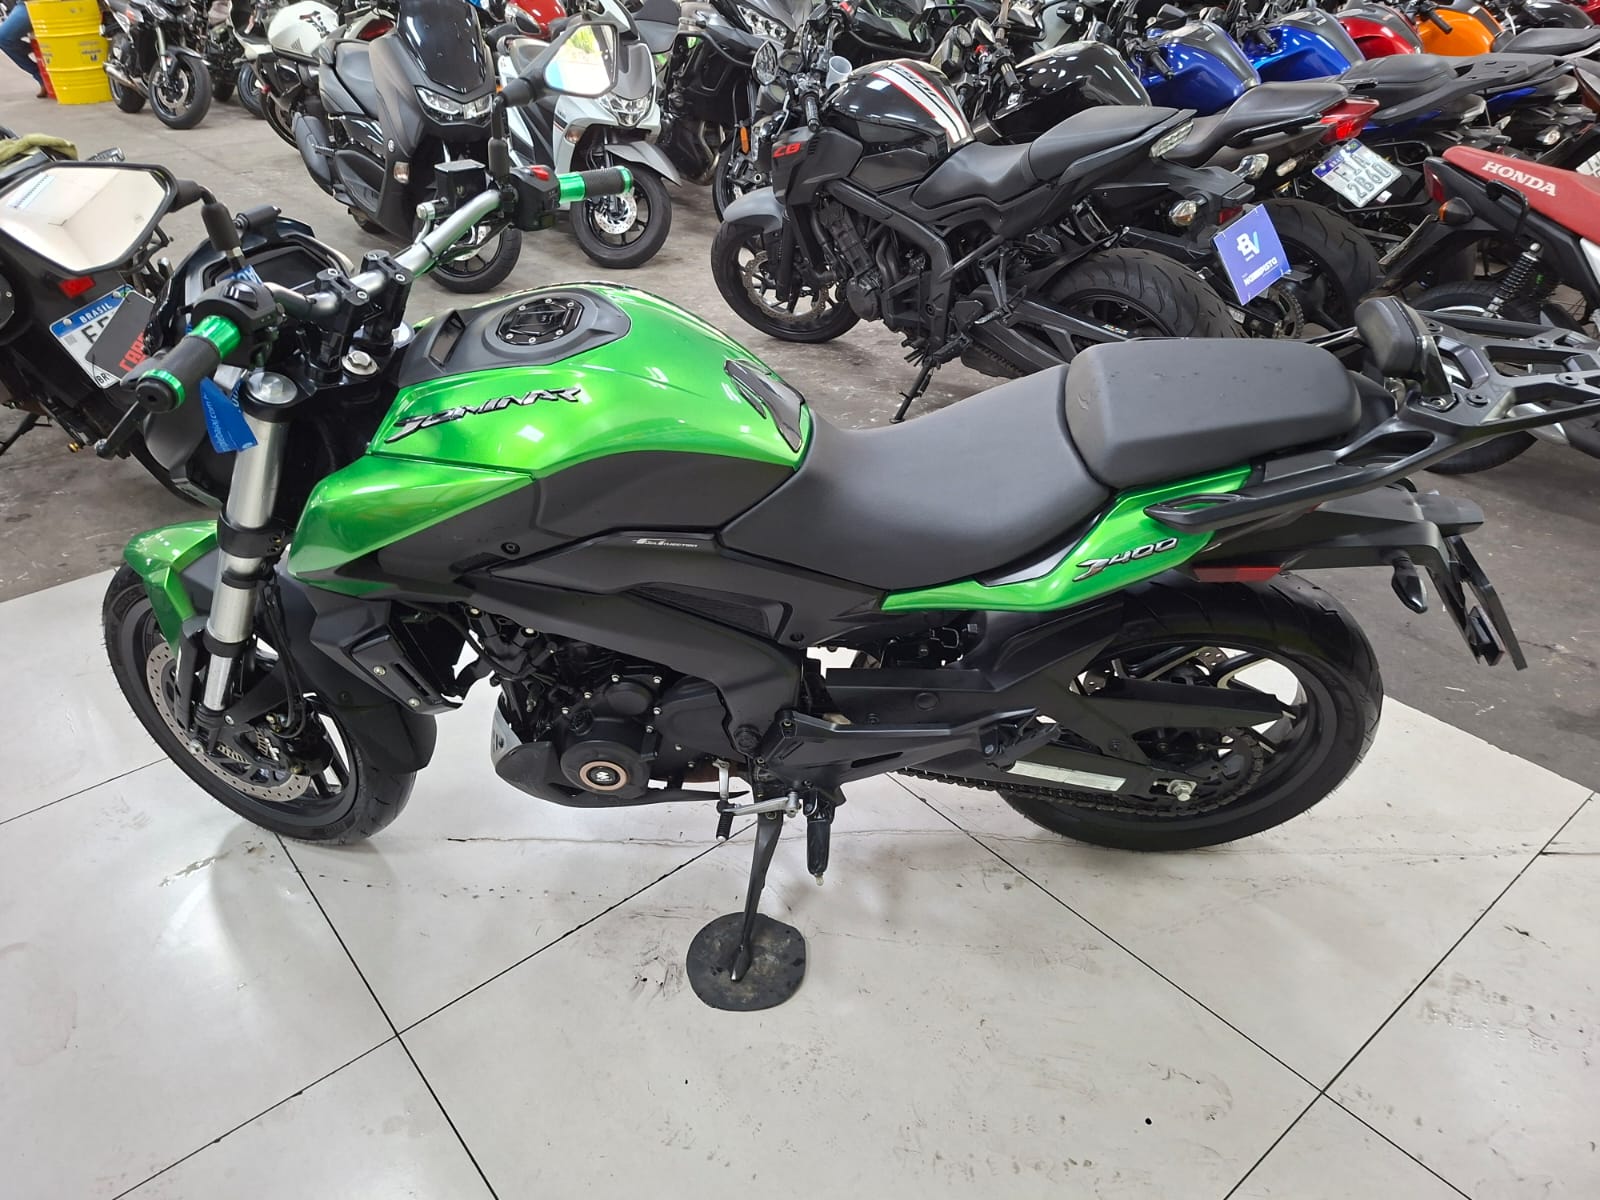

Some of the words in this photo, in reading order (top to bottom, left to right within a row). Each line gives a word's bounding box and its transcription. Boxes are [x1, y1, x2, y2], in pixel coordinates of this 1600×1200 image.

[1347, 162, 1393, 198] 2B60
[1481, 160, 1557, 197] HONDA
[79, 302, 113, 324] BRASIL
